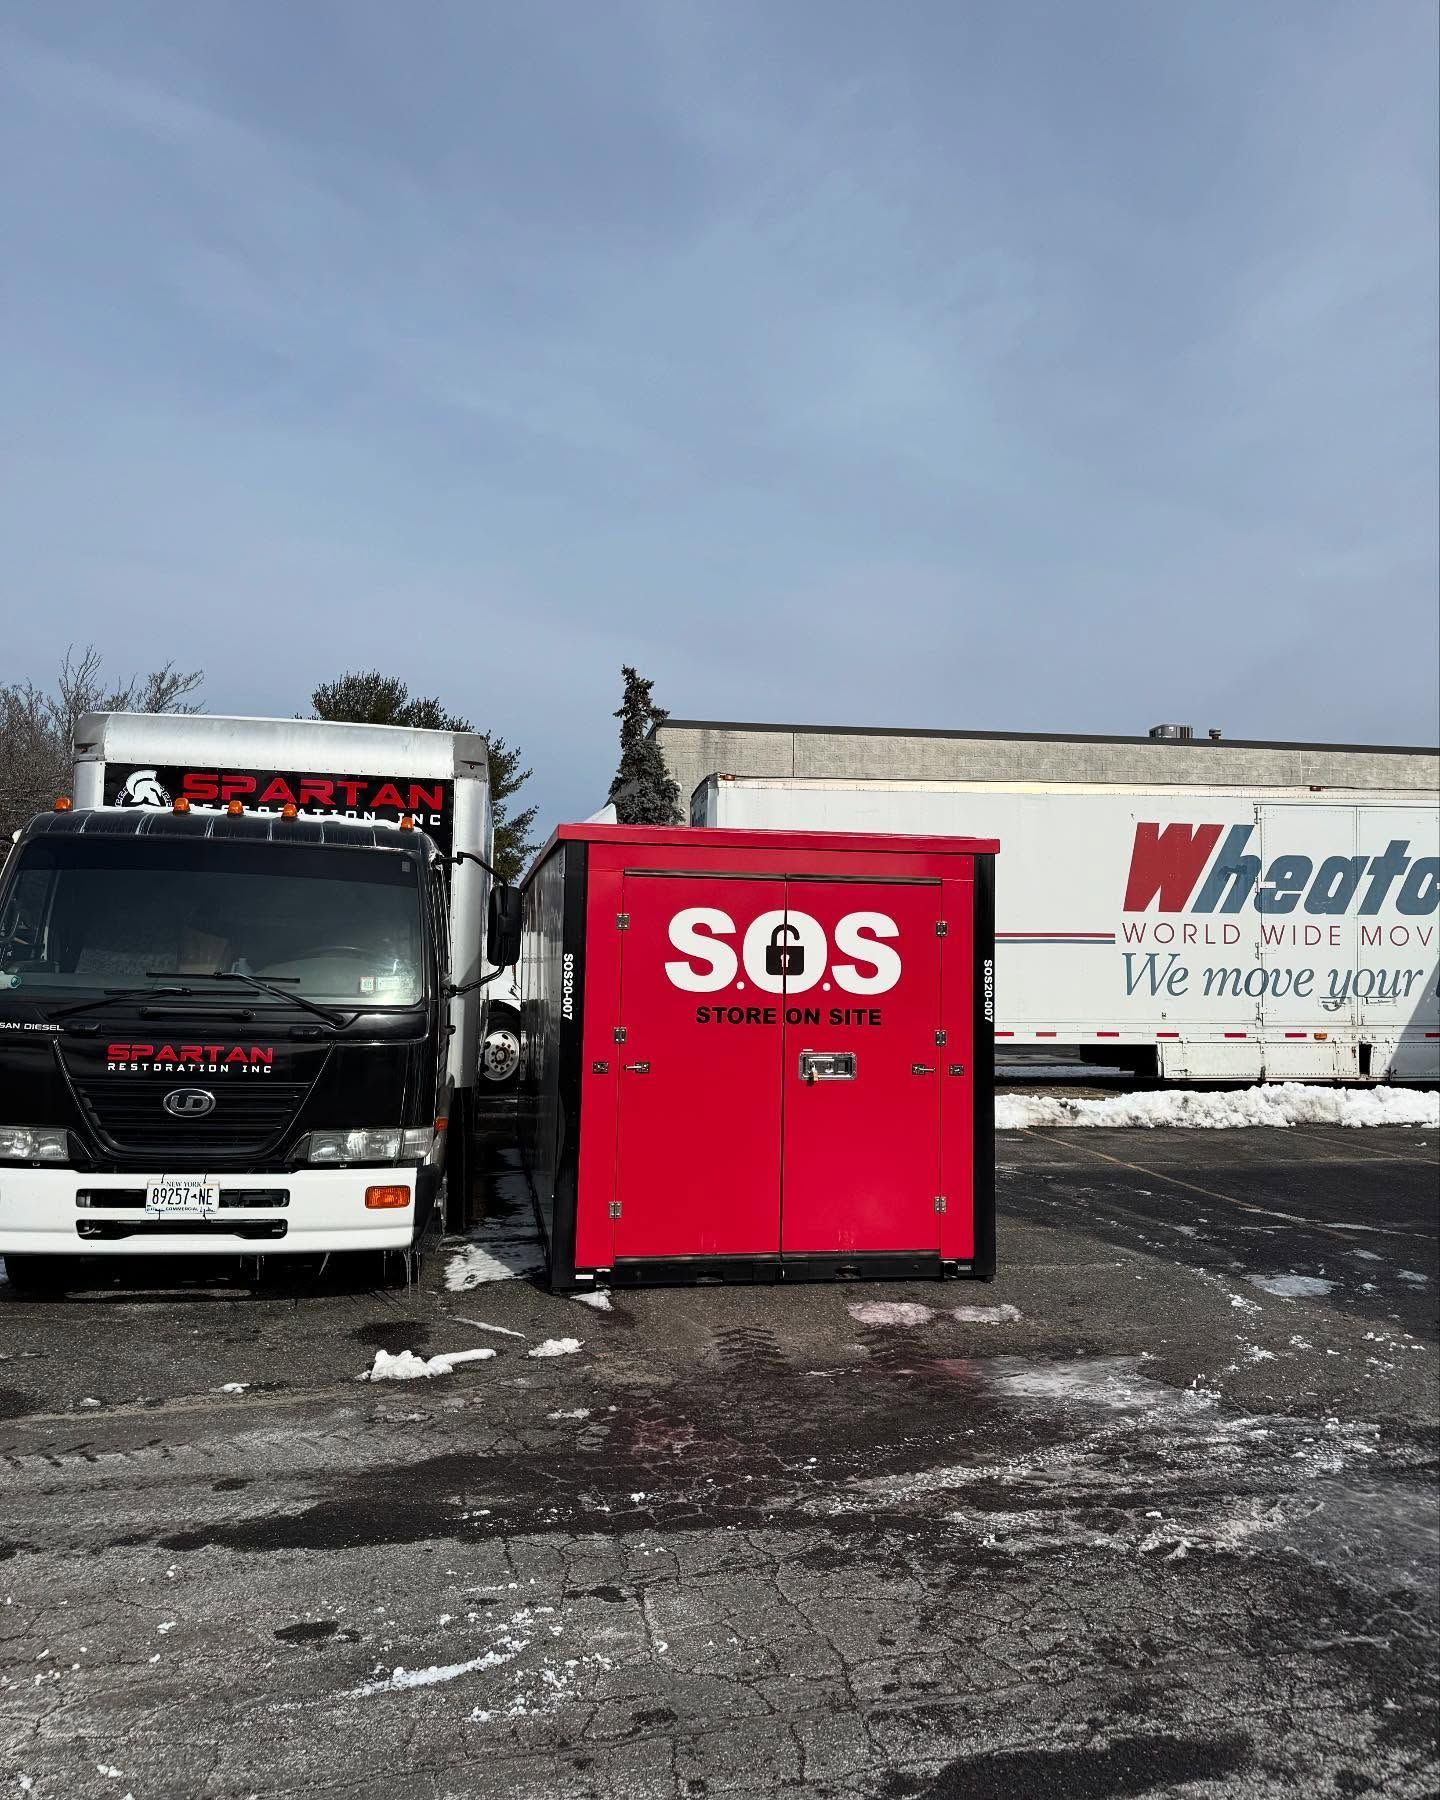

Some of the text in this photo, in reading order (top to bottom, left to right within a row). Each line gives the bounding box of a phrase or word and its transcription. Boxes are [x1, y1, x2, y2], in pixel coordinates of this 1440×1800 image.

[182, 773, 443, 810] SPARTAN
[398, 812, 441, 826] INC
[1123, 822, 1440, 916] Wheato
[1122, 922, 1435, 947] WORLD WIDE MOV
[664, 906, 902, 996] S.O.S
[562, 952, 574, 1021] SOS20-007
[983, 959, 994, 1023] SOS20-007
[1122, 952, 1190, 997] We
[1203, 967, 1314, 998] move
[1322, 967, 1424, 1012] your
[23, 1023, 65, 1031] DIESEL
[695, 1006, 883, 1027] STORE ON SITE
[107, 1044, 273, 1064] SPARTAN
[107, 1063, 272, 1074] RESTORATION INC
[170, 1095, 211, 1112] UD
